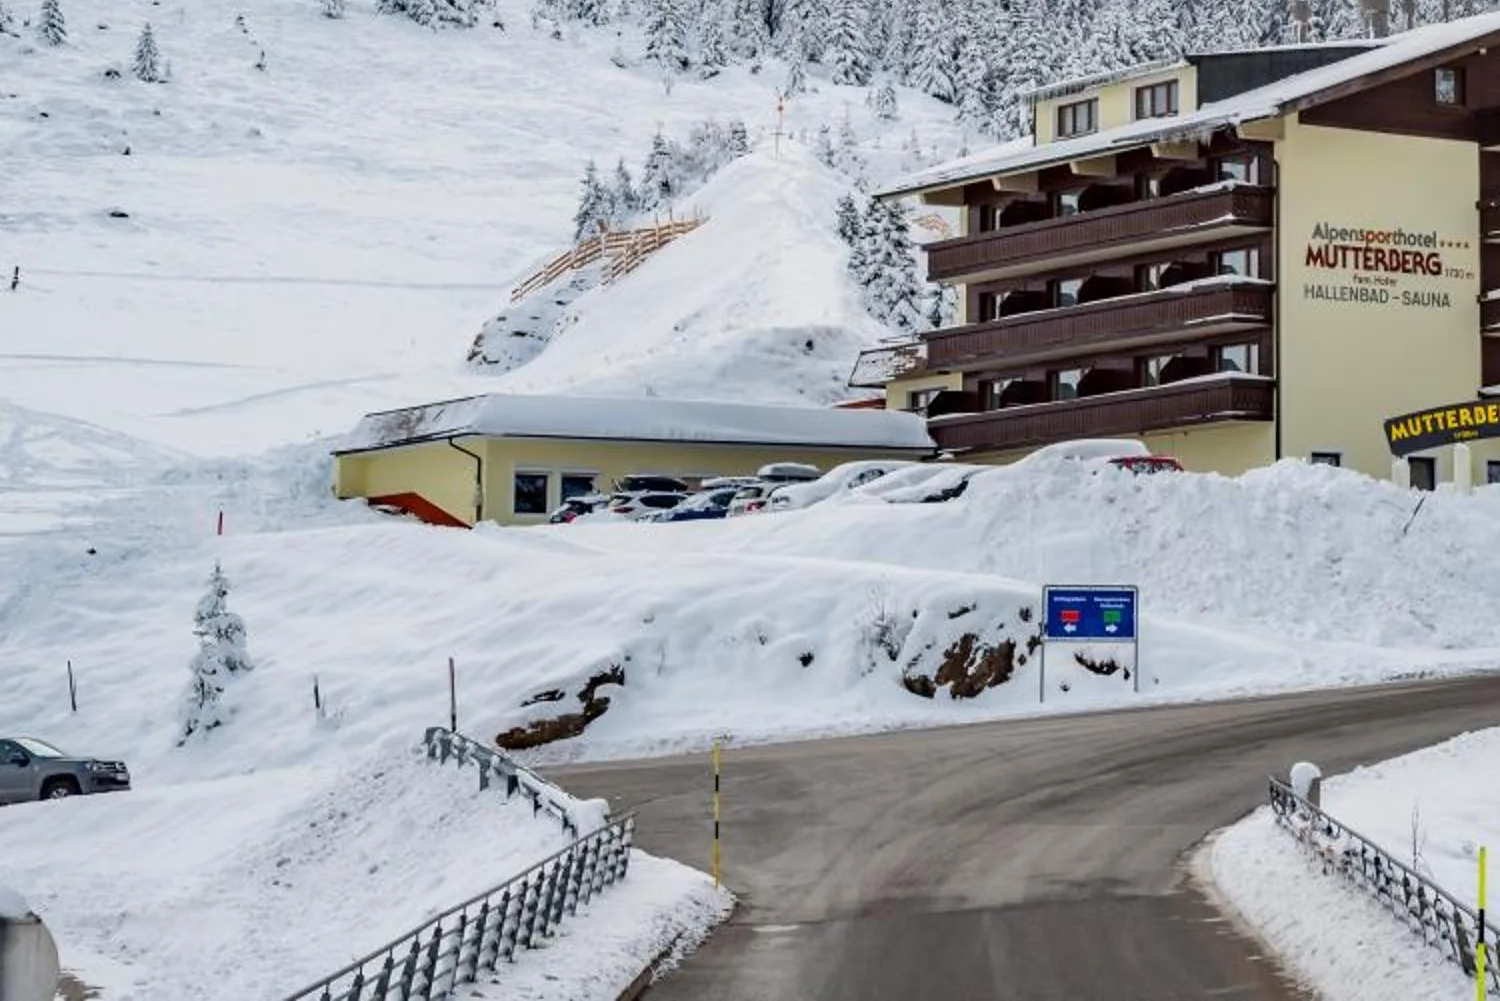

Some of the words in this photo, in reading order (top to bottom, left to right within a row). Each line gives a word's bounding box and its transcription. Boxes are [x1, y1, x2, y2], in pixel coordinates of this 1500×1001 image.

[1312, 222, 1437, 248] Alpensporthotel
[1305, 243, 1443, 276] MUTTERBERG
[1304, 284, 1389, 304] HALLENBAD
[1402, 290, 1451, 307] SAUNA
